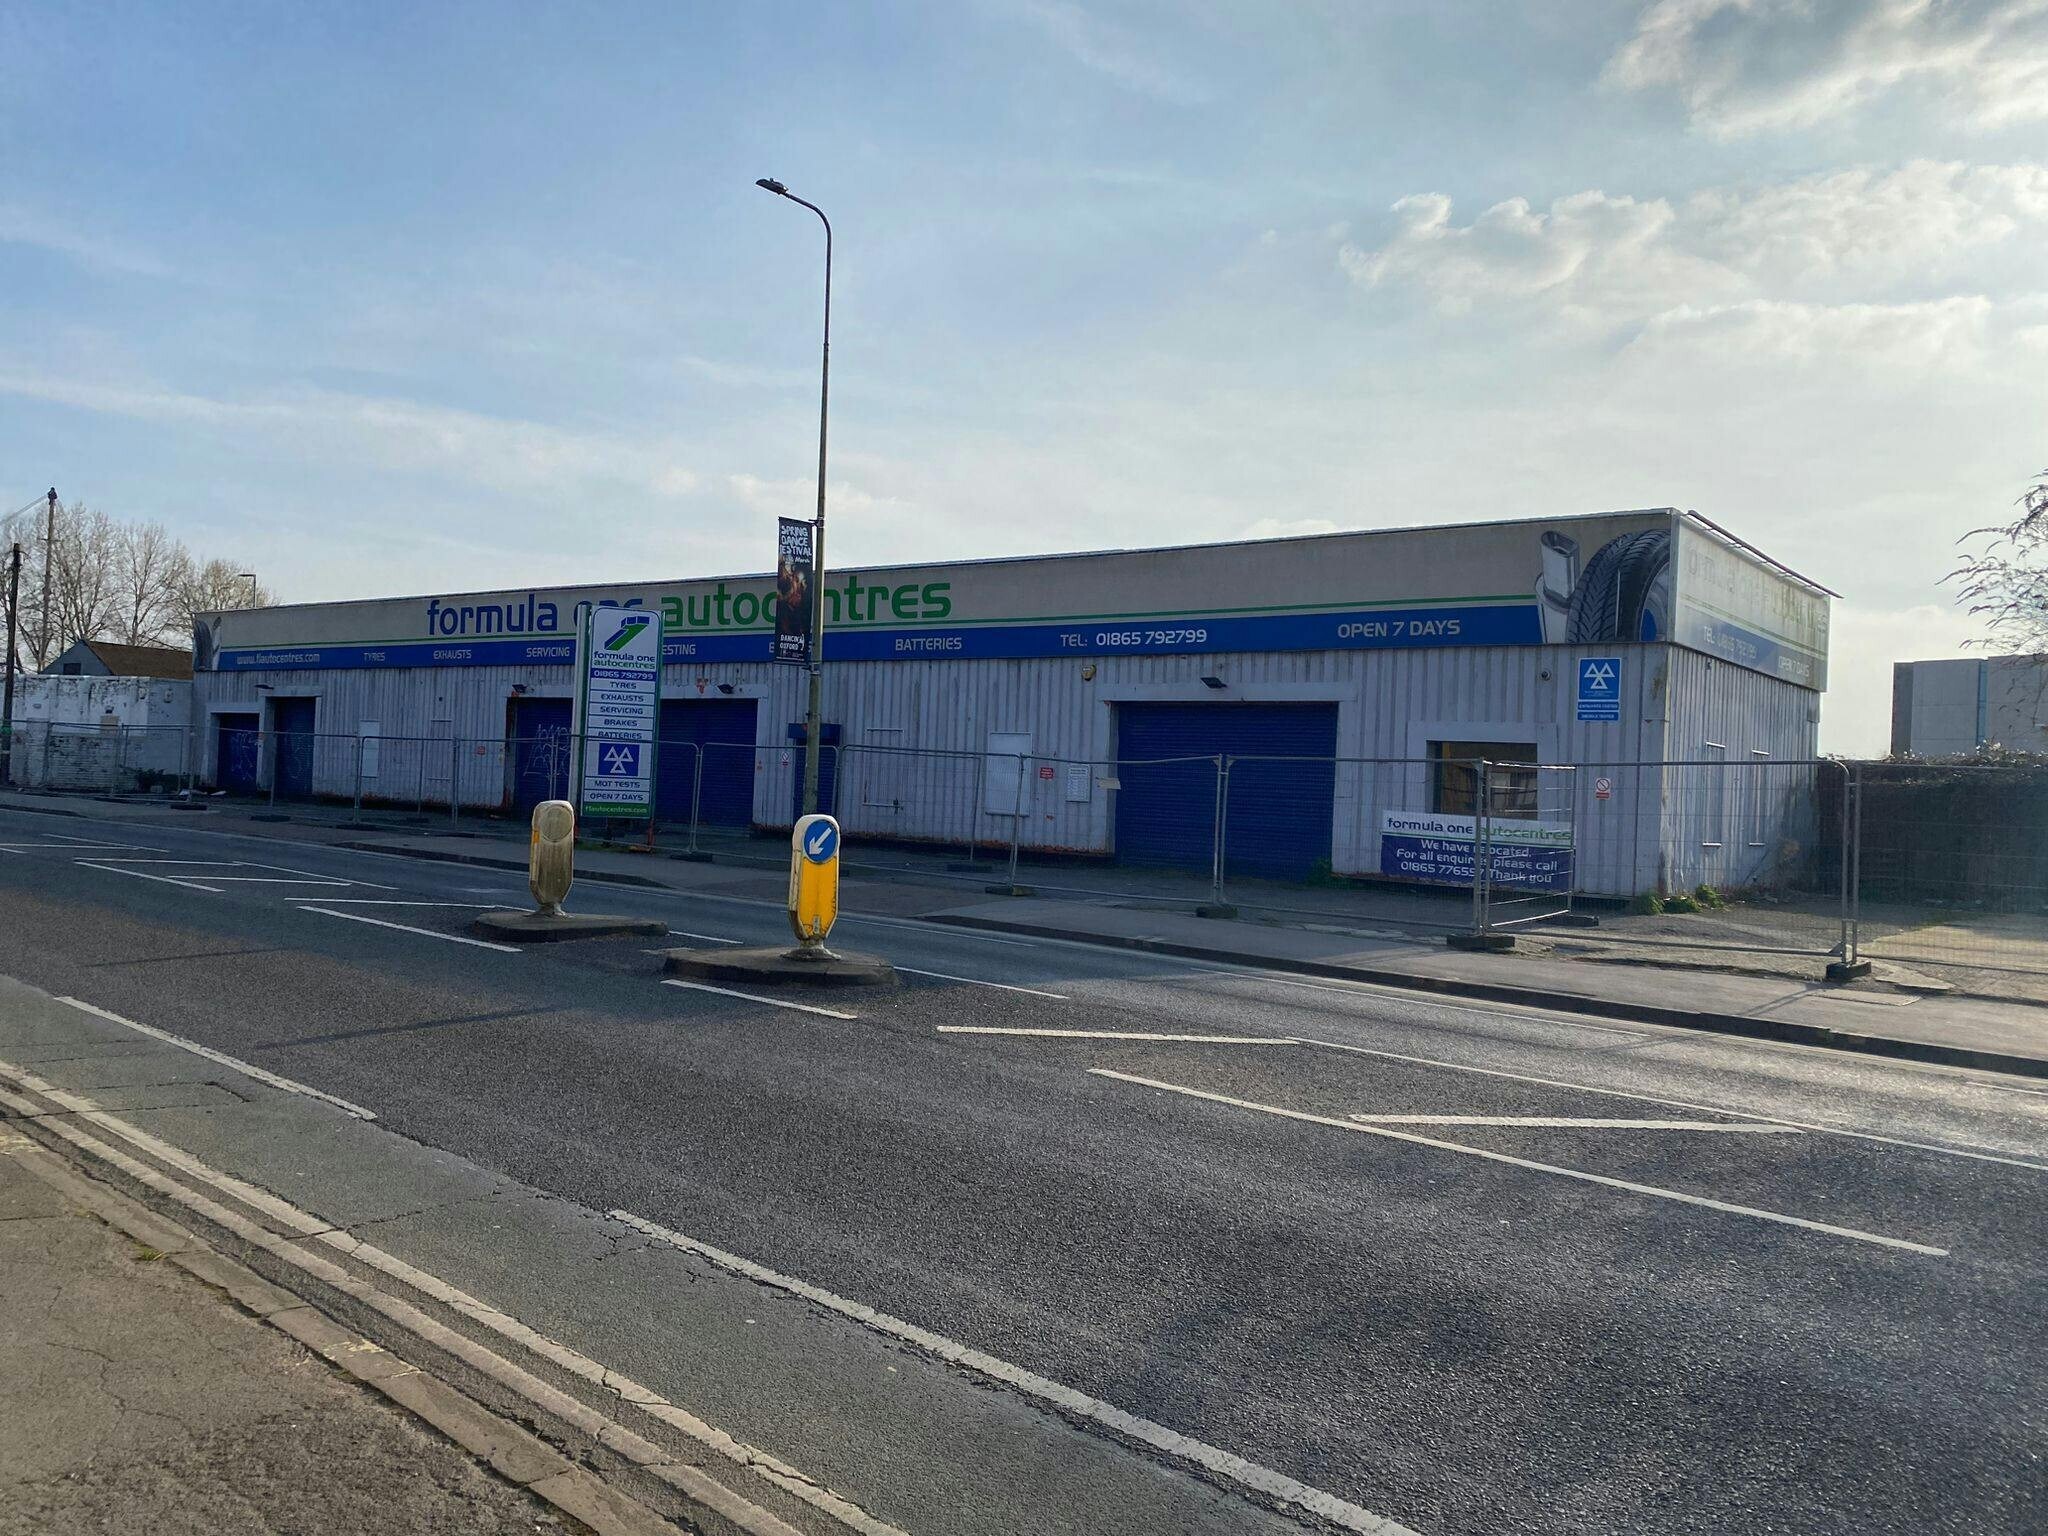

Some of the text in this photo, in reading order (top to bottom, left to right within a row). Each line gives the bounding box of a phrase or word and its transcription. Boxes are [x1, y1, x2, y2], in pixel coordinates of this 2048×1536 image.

[781, 525, 808, 537] SPRING
[781, 535, 808, 547] DANCE
[427, 593, 557, 635] formula
[661, 575, 951, 627] autocntres
[363, 652, 386, 662] TYRES
[433, 649, 472, 660] EXHAUSTS
[526, 647, 570, 658] SERVICING
[662, 644, 696, 655] ESTING
[895, 637, 962, 651] BATTERIES
[1060, 633, 1088, 647] TEL:
[1096, 631, 1142, 646] 01865
[1145, 629, 1207, 645] 792799
[1337, 622, 1387, 638] OPEN
[1392, 621, 1405, 636] 7
[1409, 619, 1460, 636] DAYS
[594, 650, 655, 663] formula one
[593, 659, 655, 670] autocentres
[593, 670, 653, 680] 01865 792799
[610, 681, 637, 689] TYRES
[601, 693, 644, 702] EXHAUSTS
[600, 706, 643, 715] SERVICING
[604, 719, 637, 727] BRAKES
[598, 730, 642, 740] BATTERIES
[615, 781, 641, 789] TESTS
[590, 792, 612, 800] OPEN
[1388, 817, 1443, 833] formula
[1447, 824, 1473, 835] one
[1421, 839, 1439, 851] We
[1442, 841, 1470, 853] have
[1396, 848, 1417, 860] For
[1420, 851, 1434, 861] all
[1493, 857, 1533, 870] please
[1536, 860, 1558, 872] call
[1401, 860, 1436, 874] 01865
[1489, 868, 1526, 881] Thank
[1529, 873, 1552, 885] you
